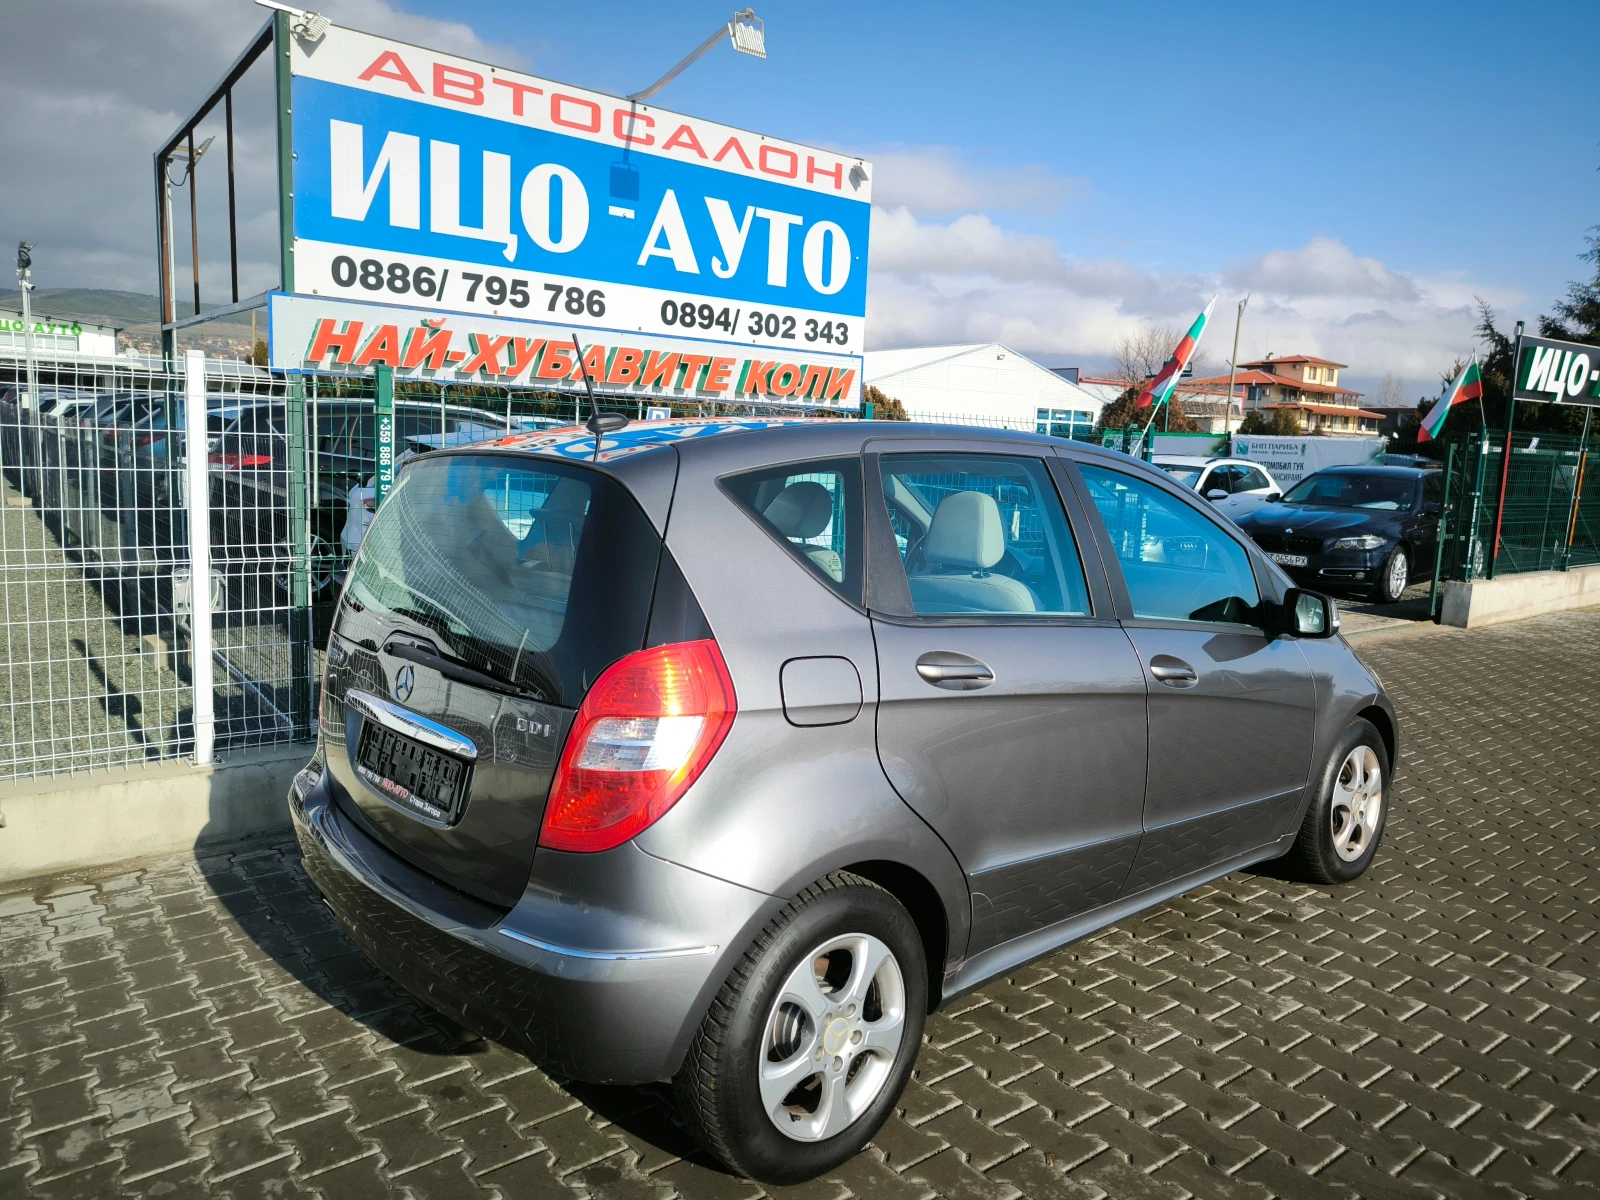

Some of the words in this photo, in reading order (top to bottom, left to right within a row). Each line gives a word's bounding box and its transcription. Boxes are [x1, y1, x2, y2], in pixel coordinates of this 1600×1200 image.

[358, 51, 842, 189] АВТОСАЛОН
[331, 255, 449, 302] 0886/
[461, 272, 530, 309] 795
[543, 283, 606, 317] 786
[660, 299, 740, 335] 0894/
[748, 311, 796, 339] 302
[804, 318, 849, 345] 343
[0, 320, 25, 332] ЦО
[33, 322, 83, 336] АУТО
[307, 317, 737, 391] НАЙ-ХУБАВИТЕ
[742, 360, 856, 400] КОЛИ
[1525, 346, 1600, 402] ИЦО-
[380, 417, 391, 443] +359
[380, 446, 391, 466] 886
[380, 468, 391, 482] 79
[1292, 462, 1304, 471] ТУК
[380, 484, 391, 495] 5
[1275, 554, 1294, 563] 0656
[516, 717, 550, 738] CDI
